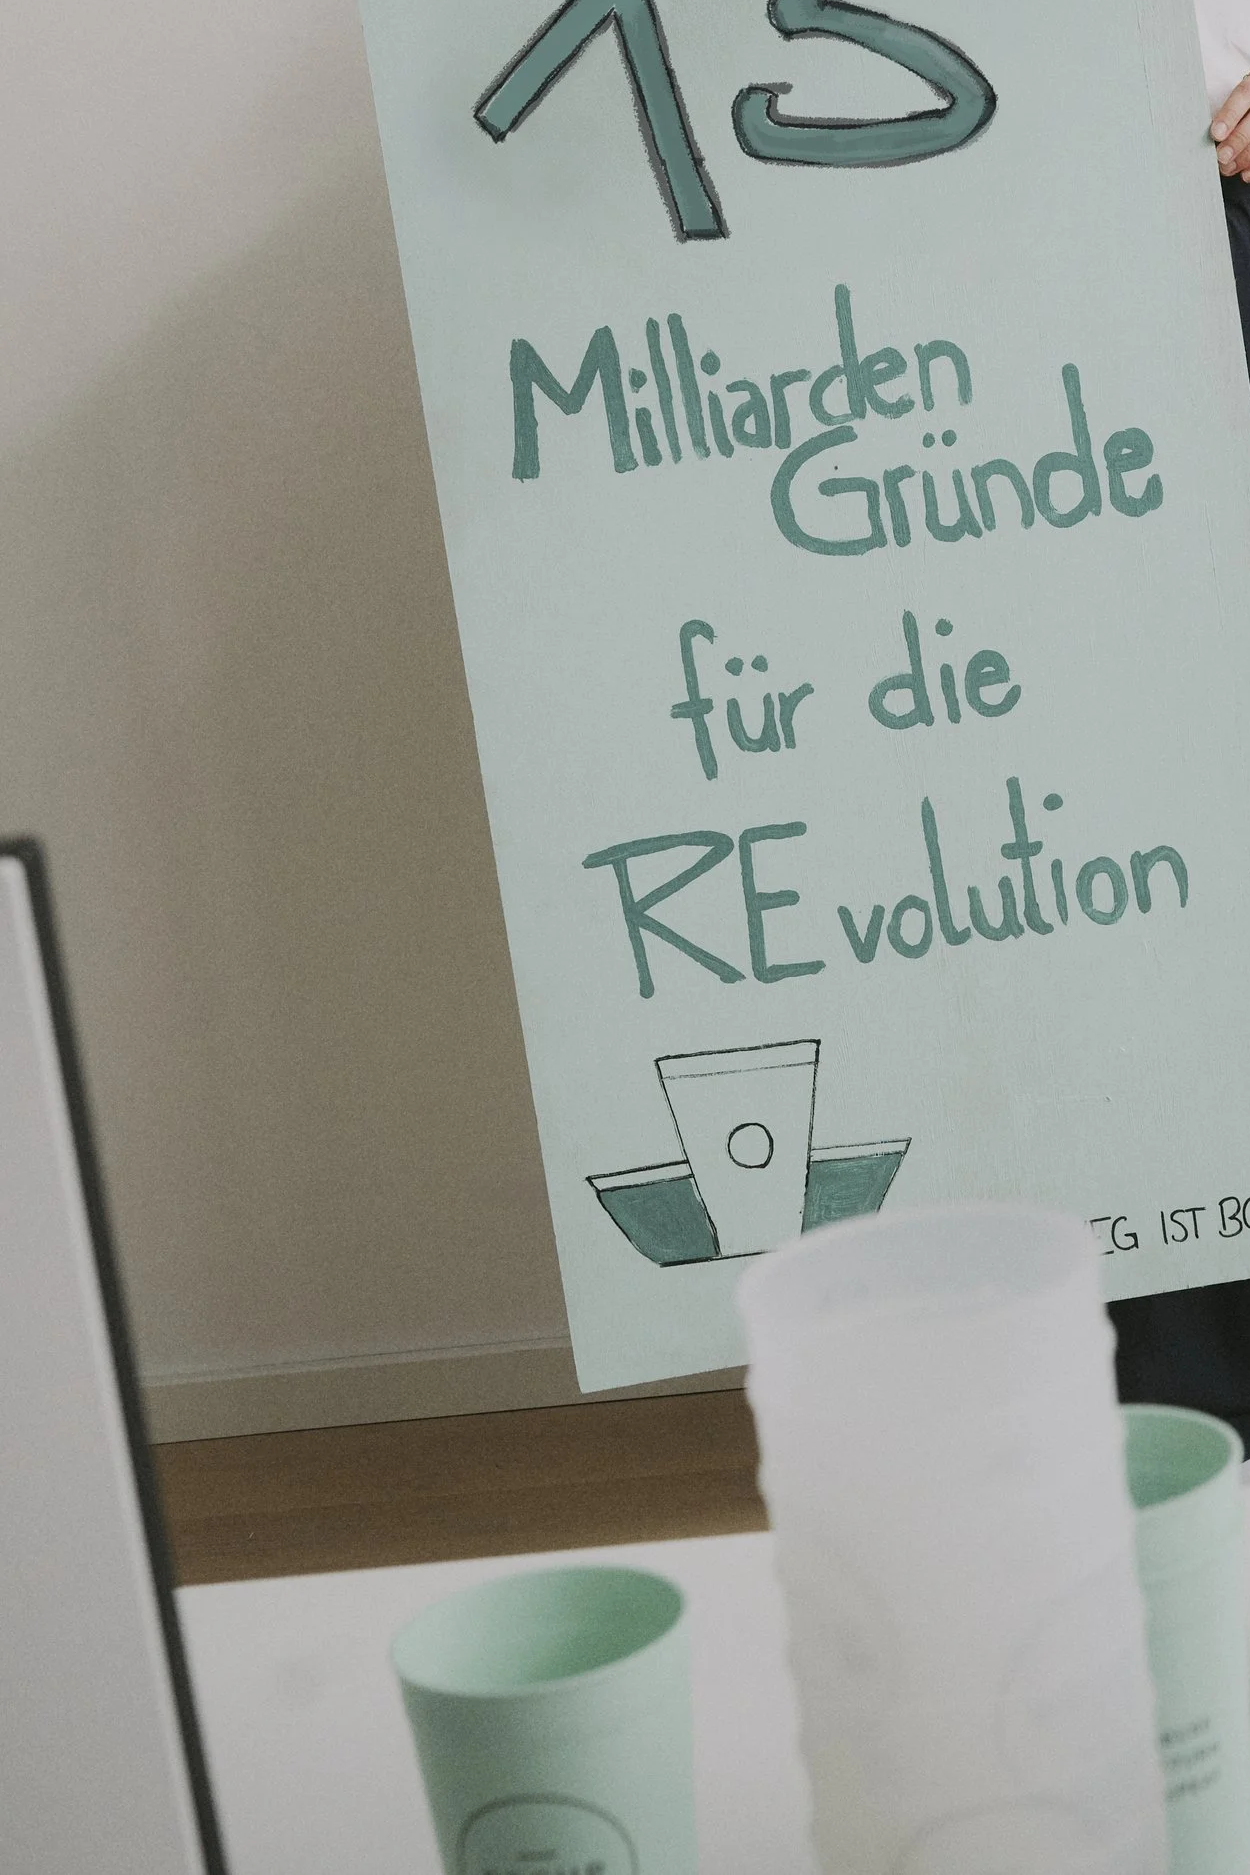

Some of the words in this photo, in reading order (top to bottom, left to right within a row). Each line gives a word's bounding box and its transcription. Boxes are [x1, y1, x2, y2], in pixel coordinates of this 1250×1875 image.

[511, 283, 973, 480] Milliarden
[770, 362, 1163, 555] Gründe
[671, 619, 814, 780] für
[868, 610, 1022, 730] die
[1160, 1206, 1206, 1245] IST
